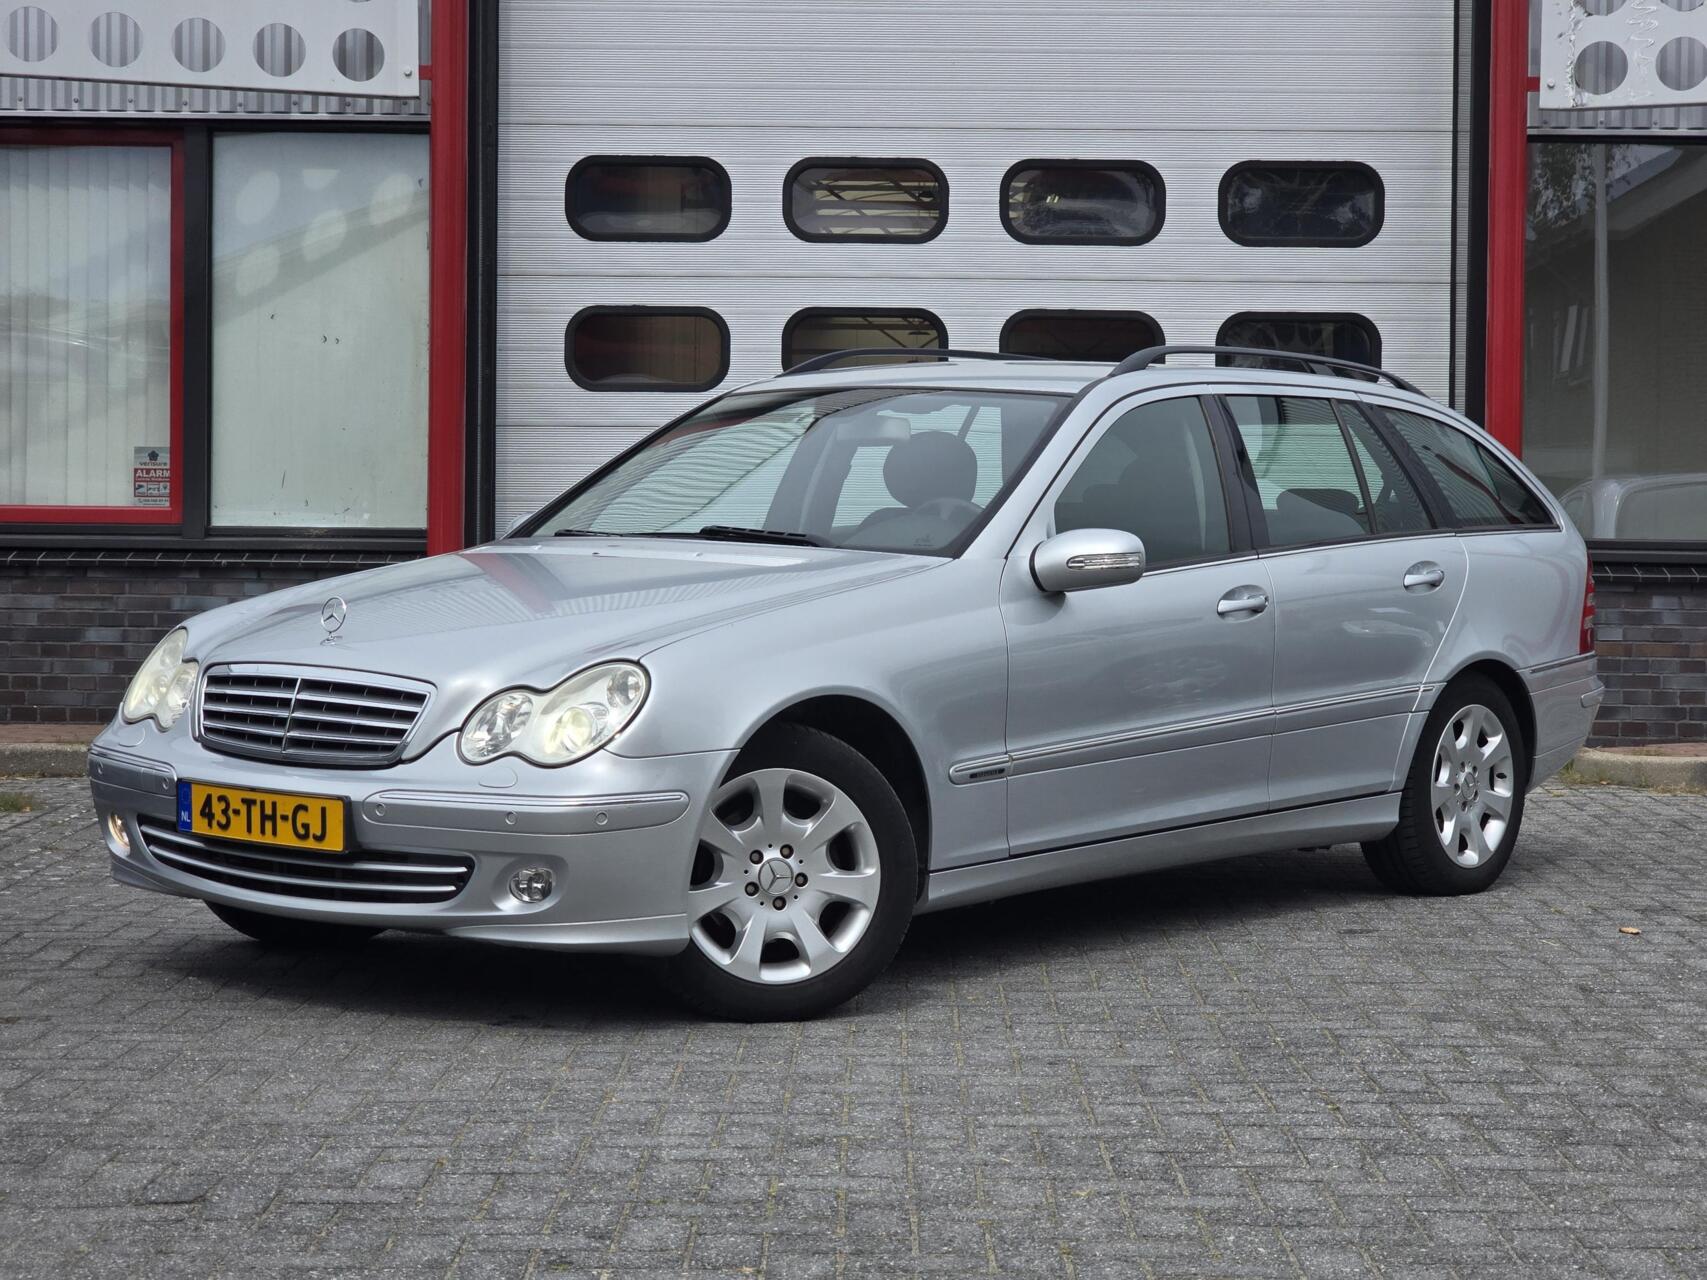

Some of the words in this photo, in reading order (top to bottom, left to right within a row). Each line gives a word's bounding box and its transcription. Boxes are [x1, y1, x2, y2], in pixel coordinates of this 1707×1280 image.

[136, 469, 171, 478] ALARM
[180, 810, 191, 823] NL
[199, 793, 328, 843] 43-TH-GJ
